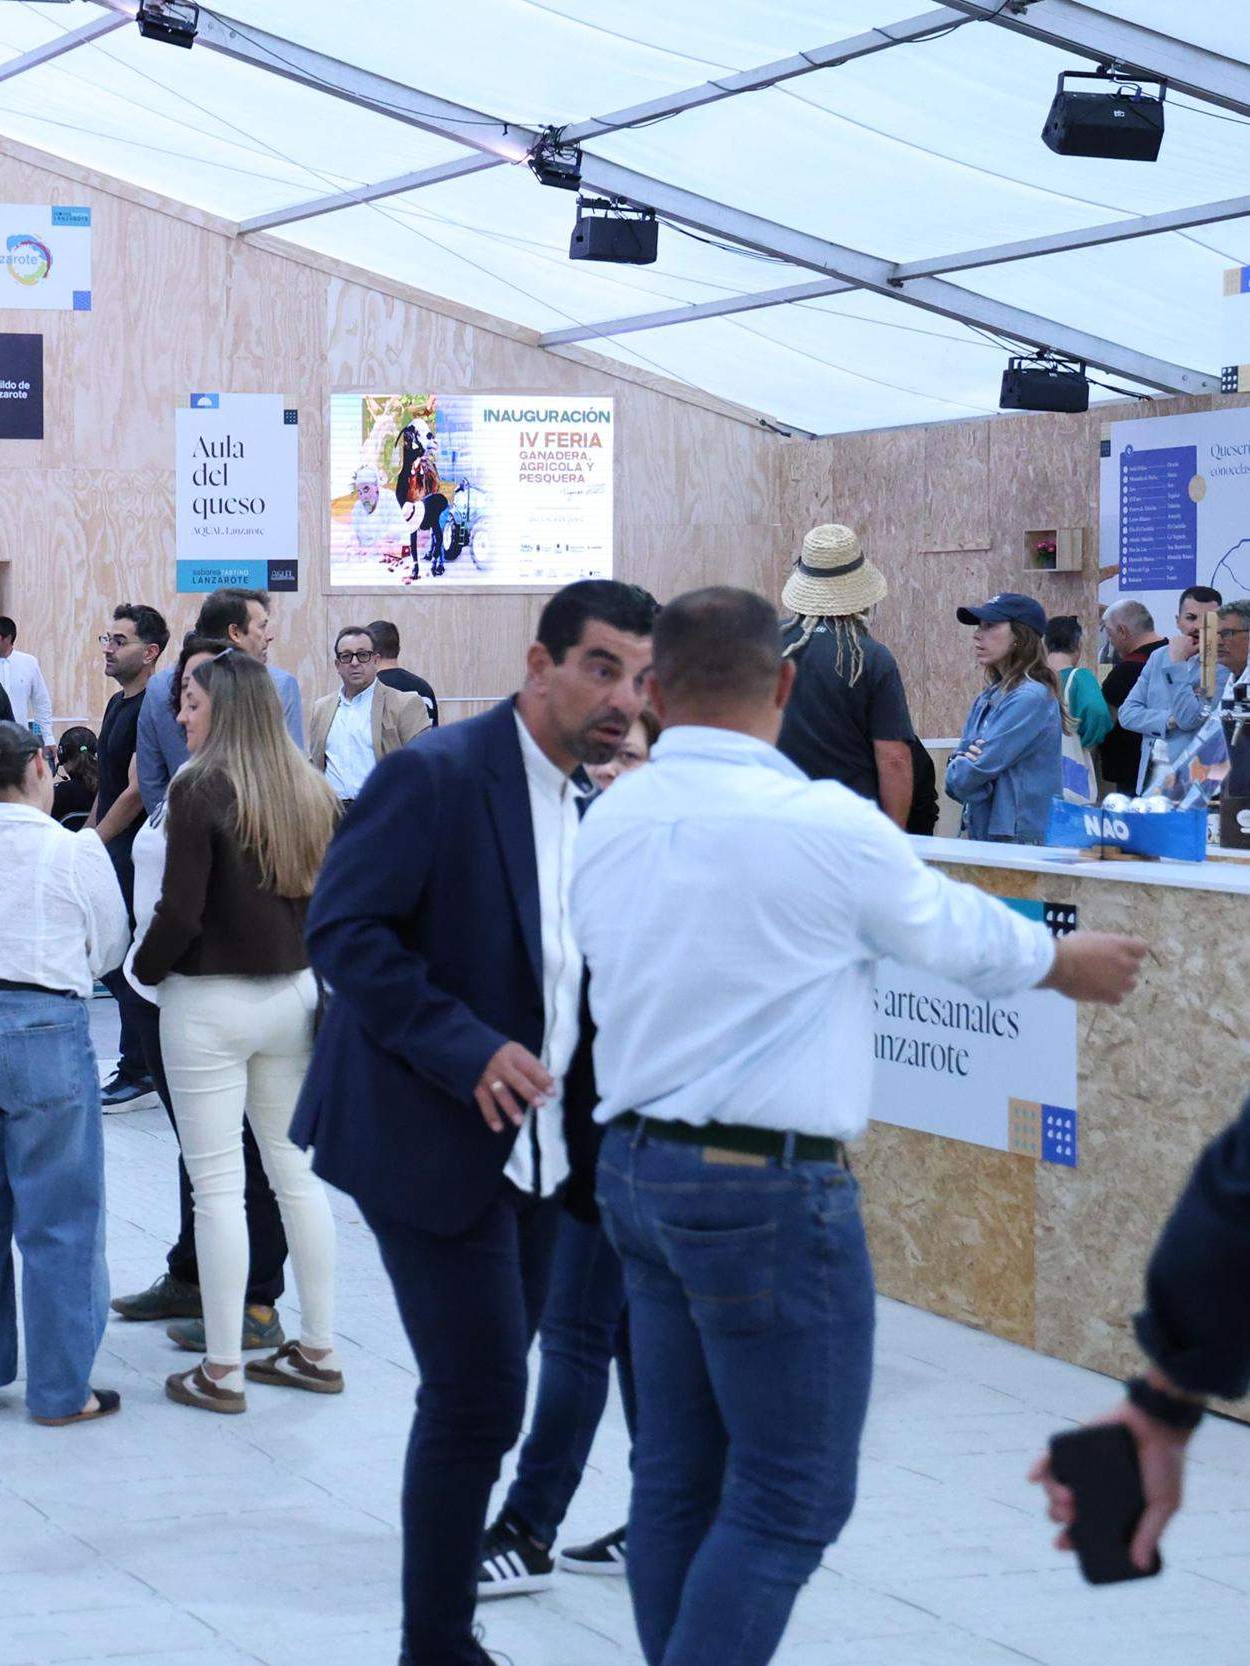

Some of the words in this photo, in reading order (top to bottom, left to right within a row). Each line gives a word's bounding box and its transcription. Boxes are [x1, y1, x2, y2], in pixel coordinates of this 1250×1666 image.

[17, 380, 31, 391] de
[483, 406, 611, 424] INAUGURACIÓN
[192, 434, 245, 459] Aula
[519, 431, 539, 448] IV
[544, 431, 603, 449] FERIA
[518, 450, 592, 462] GANADERA,
[192, 462, 228, 487] del
[586, 462, 595, 473] Y
[518, 473, 586, 484] PESQUERA
[192, 496, 266, 520] queso
[225, 526, 265, 537] Lanzarote
[192, 576, 250, 585] LANZAROTE
[1085, 816, 1129, 840] NAO
[884, 989, 1020, 1040] artesanales
[873, 1031, 970, 1077] nzarote
